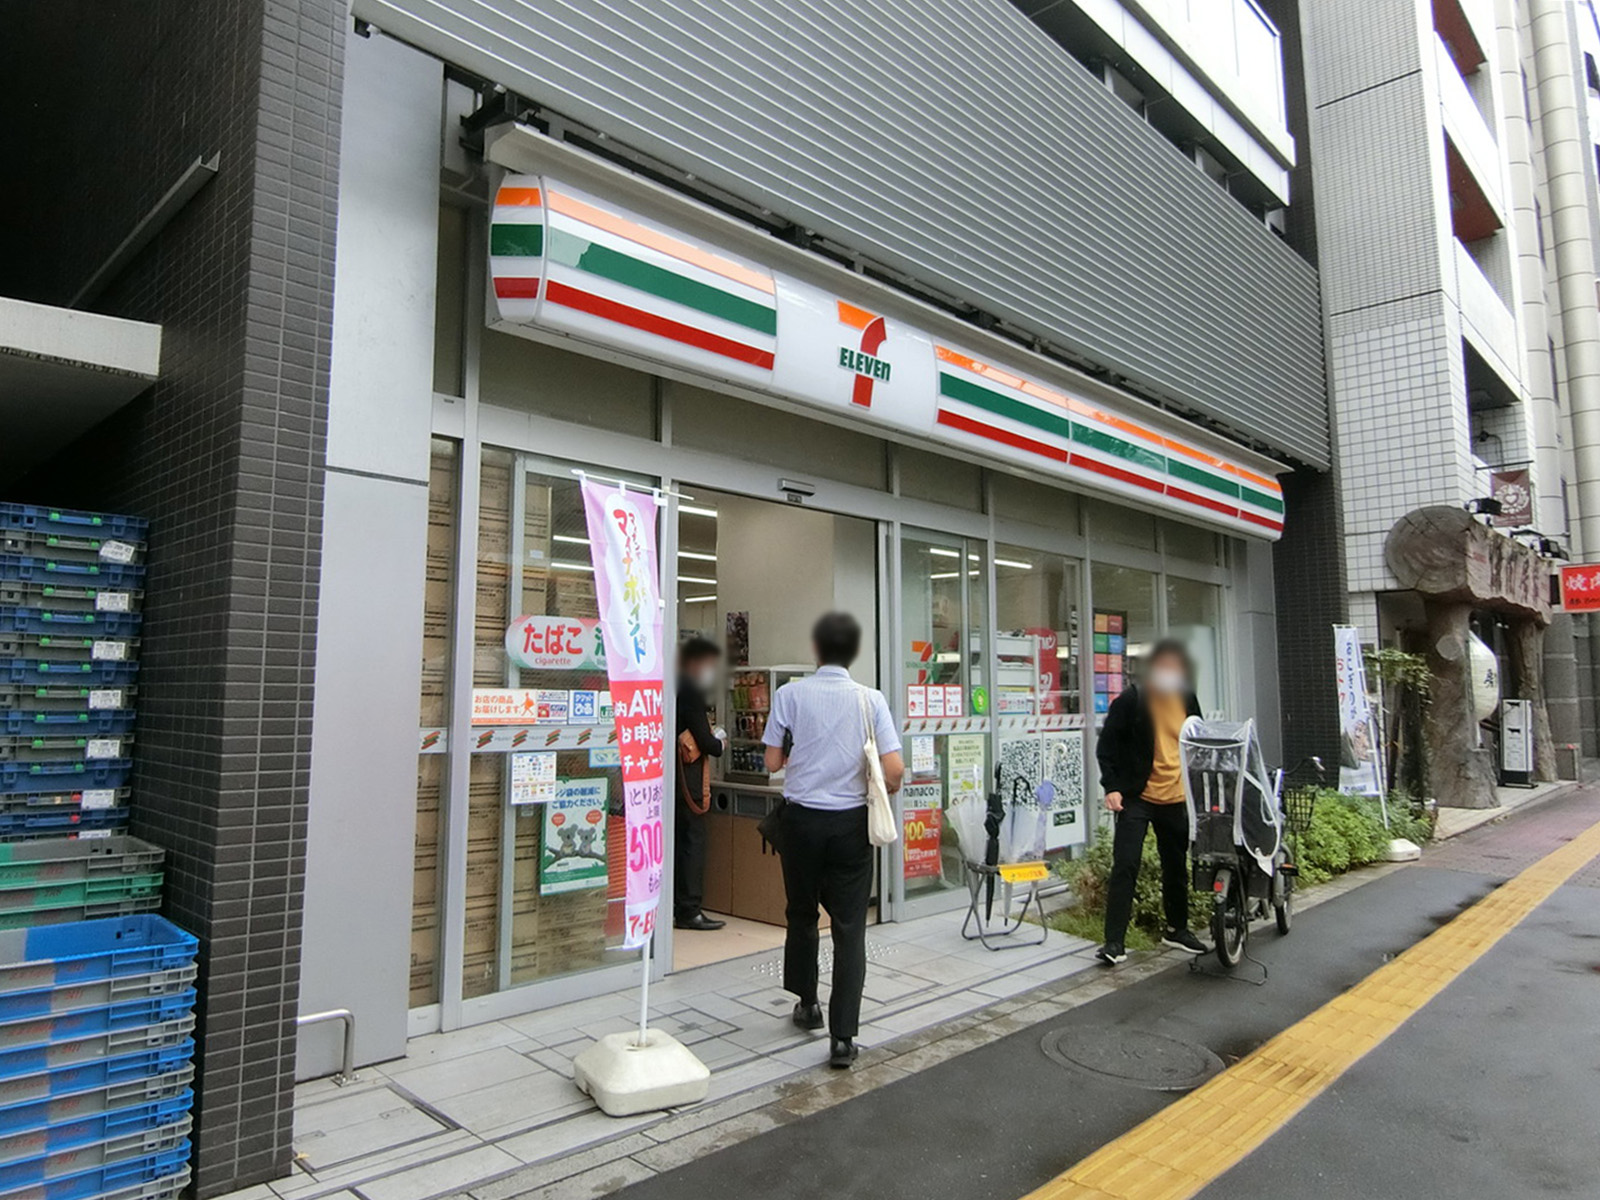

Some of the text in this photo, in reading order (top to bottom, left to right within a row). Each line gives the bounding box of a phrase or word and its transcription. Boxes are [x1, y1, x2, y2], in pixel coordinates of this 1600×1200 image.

[523, 623, 583, 655] たばこ
[534, 656, 572, 667] cigarette
[474, 695, 514, 704] お店の商品
